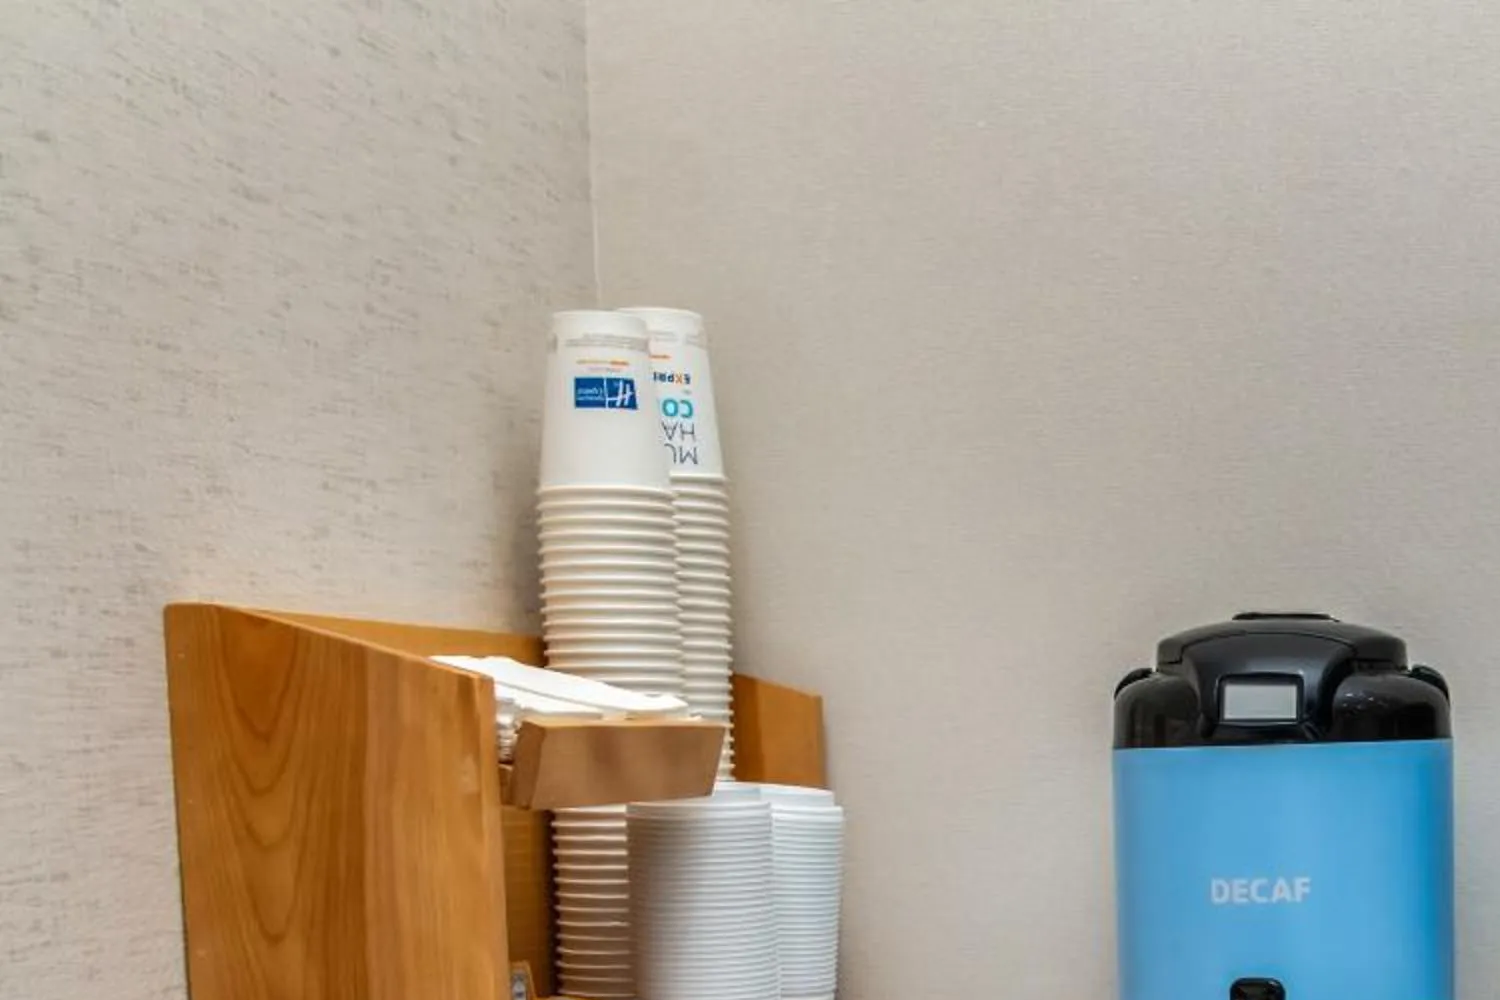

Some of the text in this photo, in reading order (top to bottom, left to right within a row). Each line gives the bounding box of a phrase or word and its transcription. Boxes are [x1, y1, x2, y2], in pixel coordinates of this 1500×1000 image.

[653, 371, 692, 385] EXPR
[661, 421, 695, 441] HA
[664, 443, 699, 465] MU
[1210, 876, 1312, 905] DECAF
